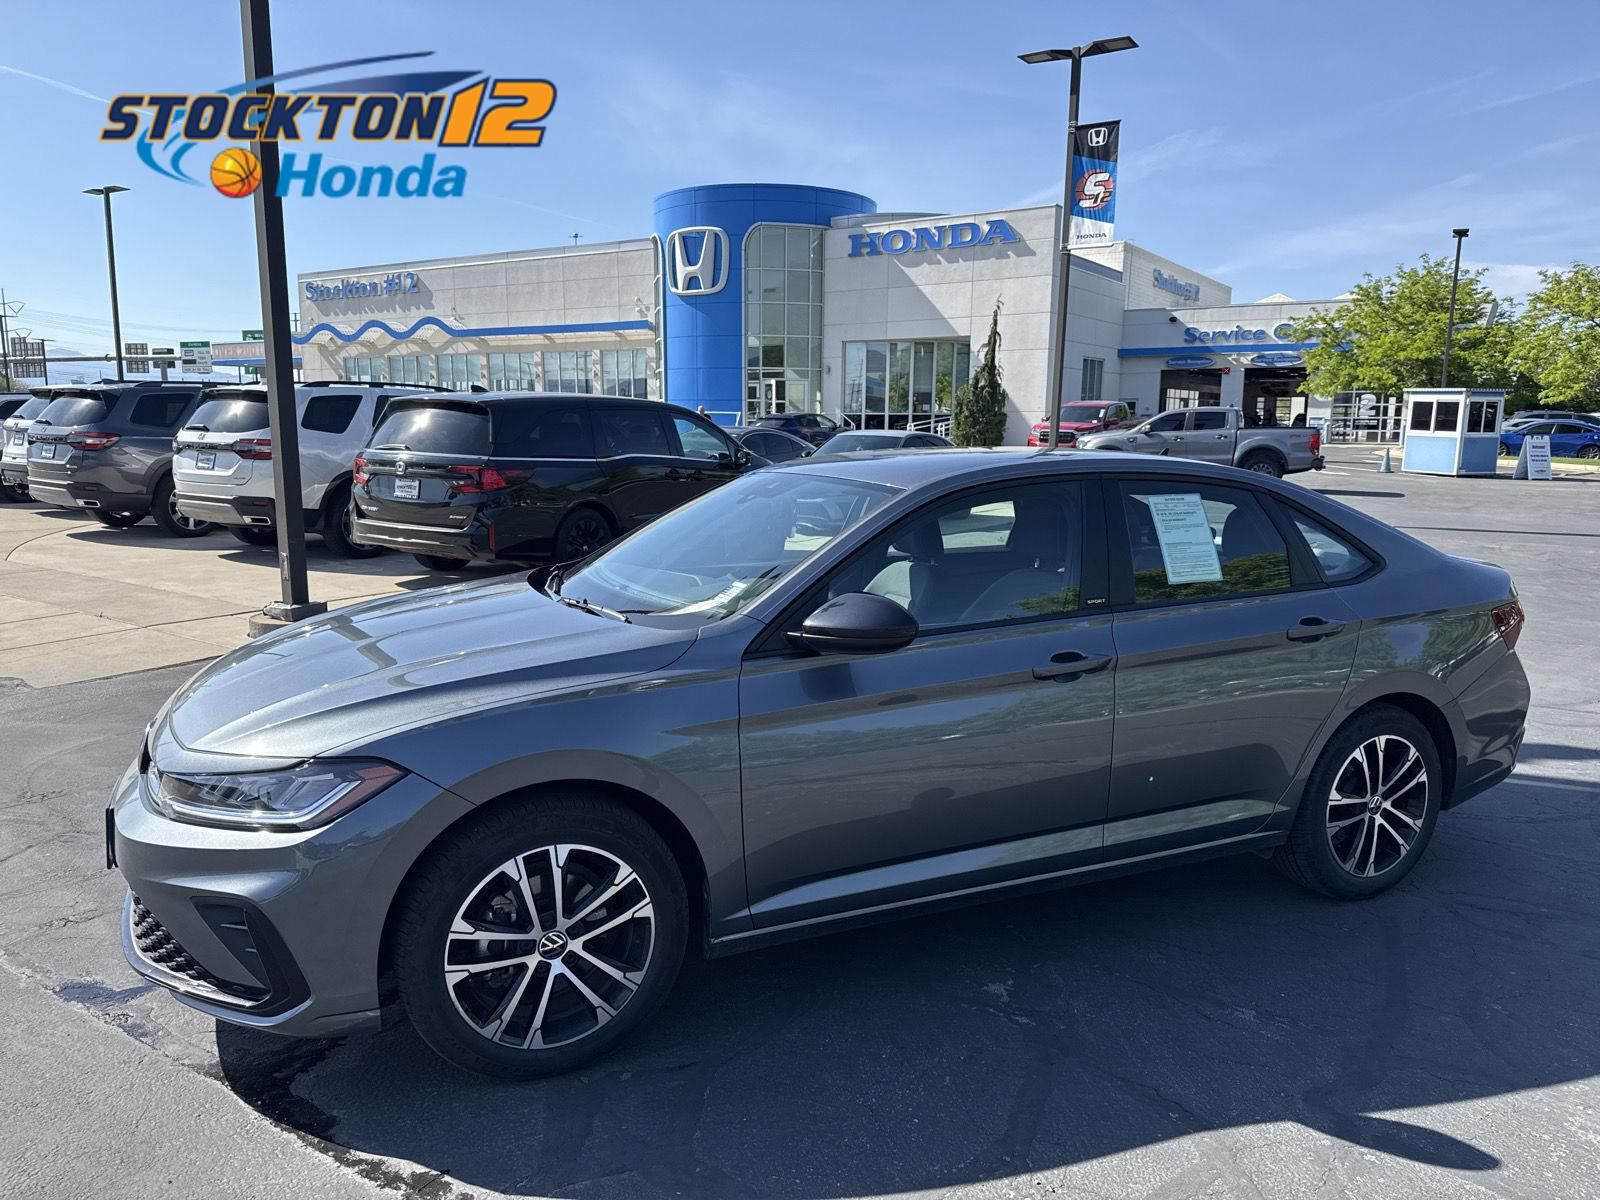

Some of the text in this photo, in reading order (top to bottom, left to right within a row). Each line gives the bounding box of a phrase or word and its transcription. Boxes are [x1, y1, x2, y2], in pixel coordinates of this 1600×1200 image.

[848, 219, 1020, 258] HONDA
[1076, 232, 1107, 240] HONDA
[305, 271, 418, 301] Stockton #12
[1183, 324, 1267, 344] Service
